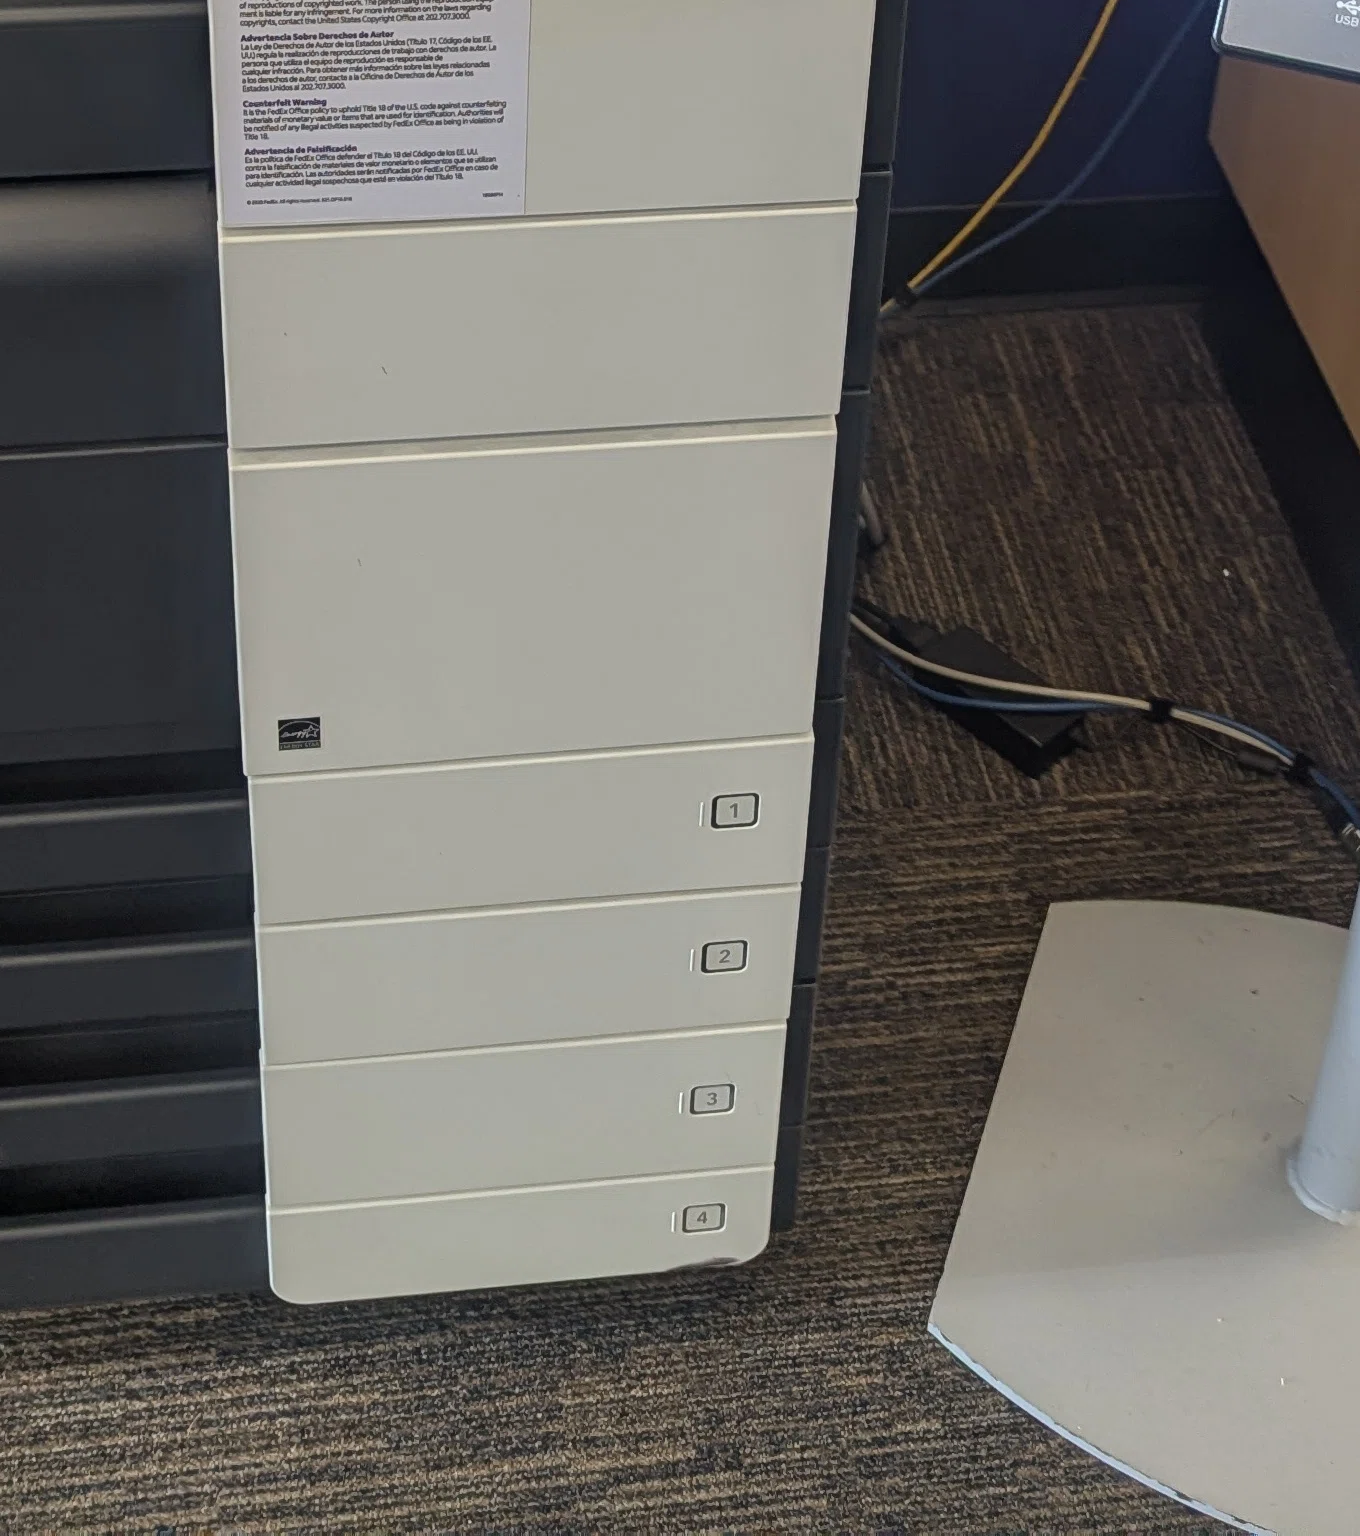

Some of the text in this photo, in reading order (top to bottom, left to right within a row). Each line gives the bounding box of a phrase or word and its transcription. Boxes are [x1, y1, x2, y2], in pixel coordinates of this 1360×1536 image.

[1335, 14, 1360, 28] USB
[291, 97, 328, 108] Warning
[729, 802, 740, 820] 1
[718, 949, 732, 964] 2
[706, 1092, 718, 1107] 3
[696, 1210, 708, 1224] 4
